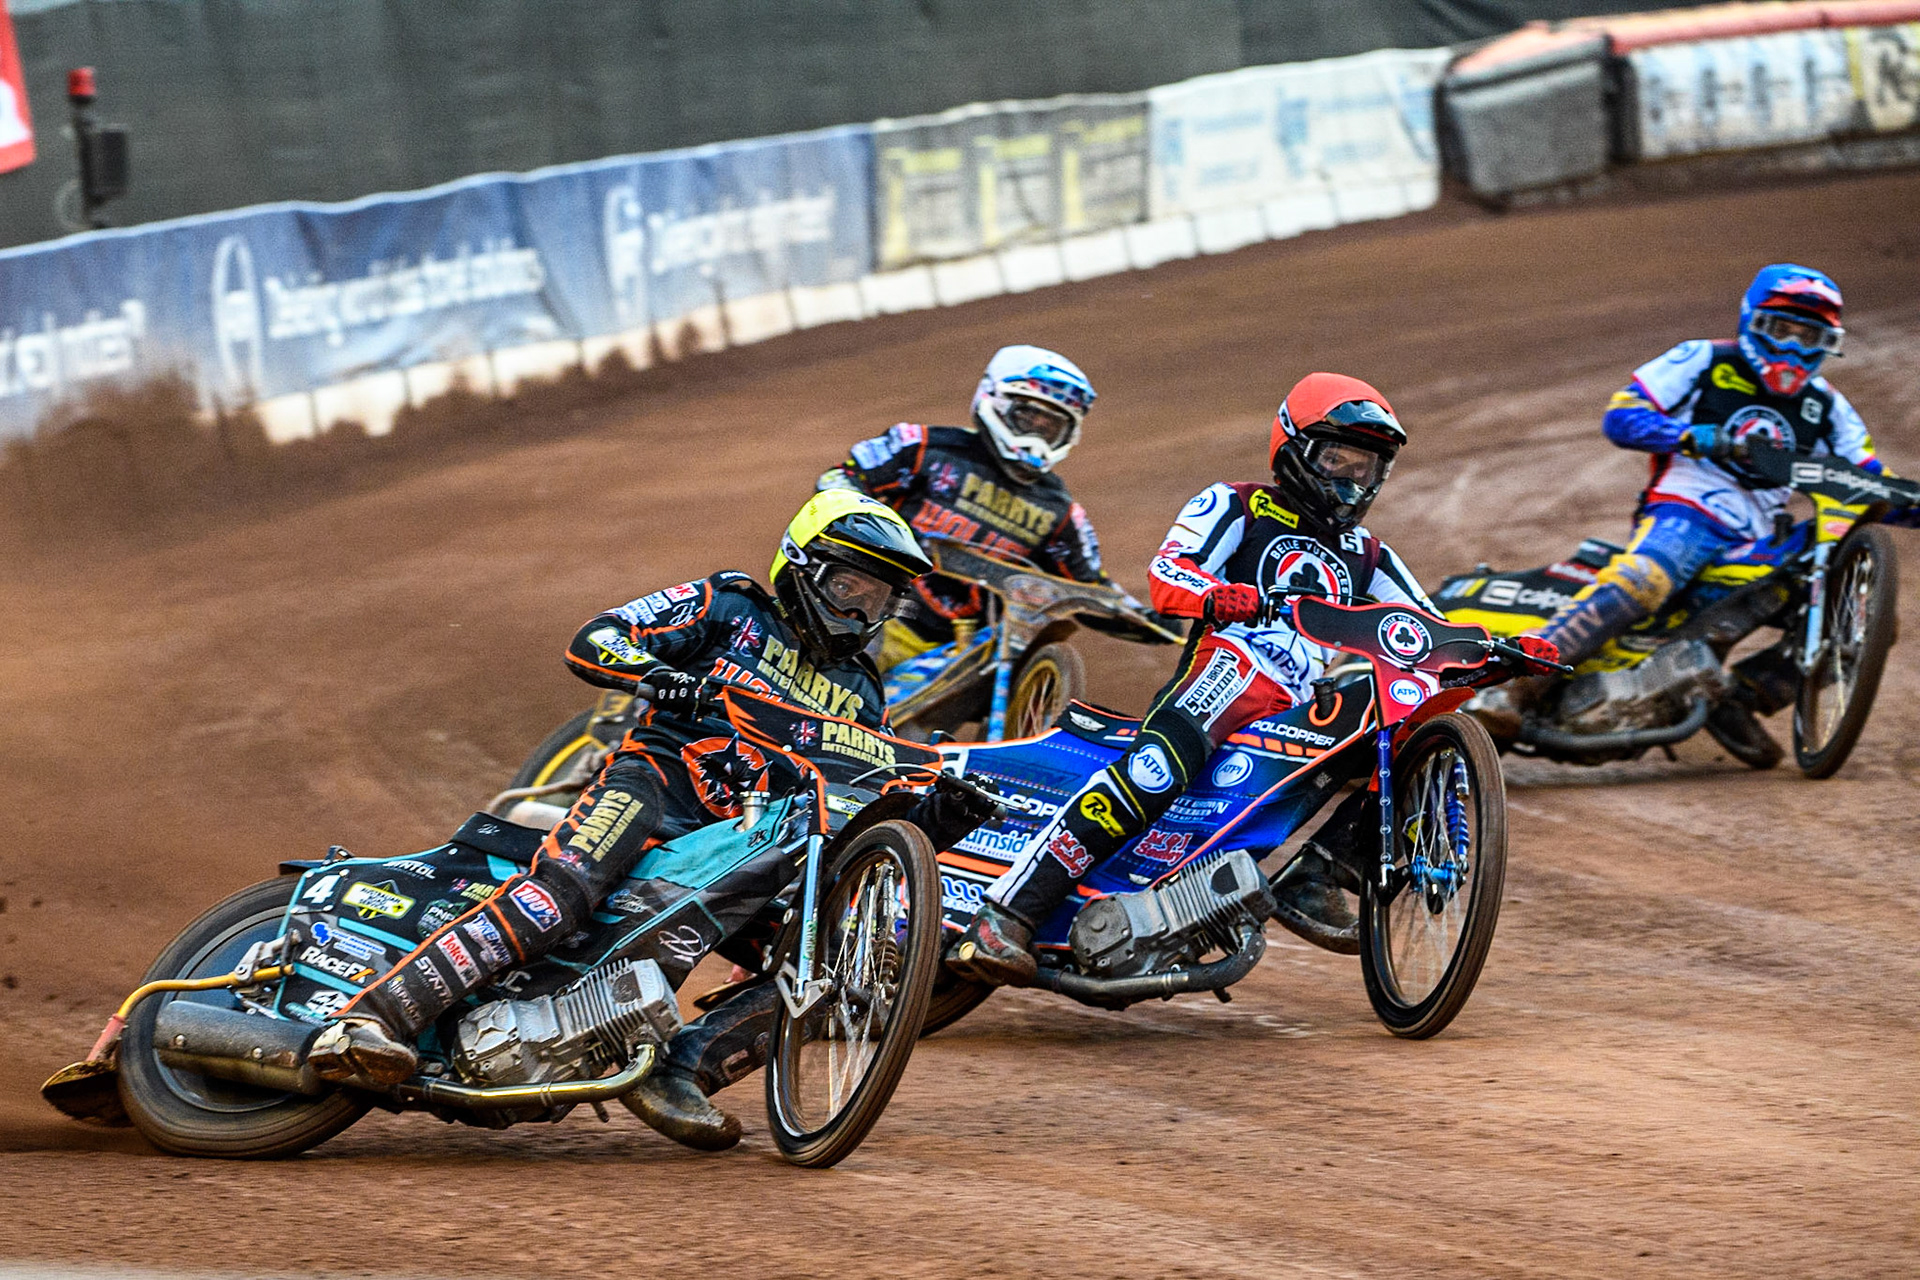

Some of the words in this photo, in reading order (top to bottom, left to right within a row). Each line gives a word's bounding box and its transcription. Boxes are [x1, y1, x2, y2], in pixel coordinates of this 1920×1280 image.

[960, 472, 1057, 537] PARRYS
[1343, 533, 1359, 551] 5
[1269, 539, 1301, 560] BELLE
[1305, 541, 1328, 561] VUE
[1329, 562, 1349, 594] ACES
[762, 634, 864, 722] PARRYS
[821, 721, 896, 766] PARRYS
[1249, 720, 1336, 747] POLCOPPER
[1138, 753, 1167, 782] ATPI
[1219, 764, 1244, 775] ATPI
[567, 789, 633, 854] PARRYS
[302, 874, 341, 904] 4
[513, 886, 558, 926] 100%
[300, 946, 377, 983] RACEFX
